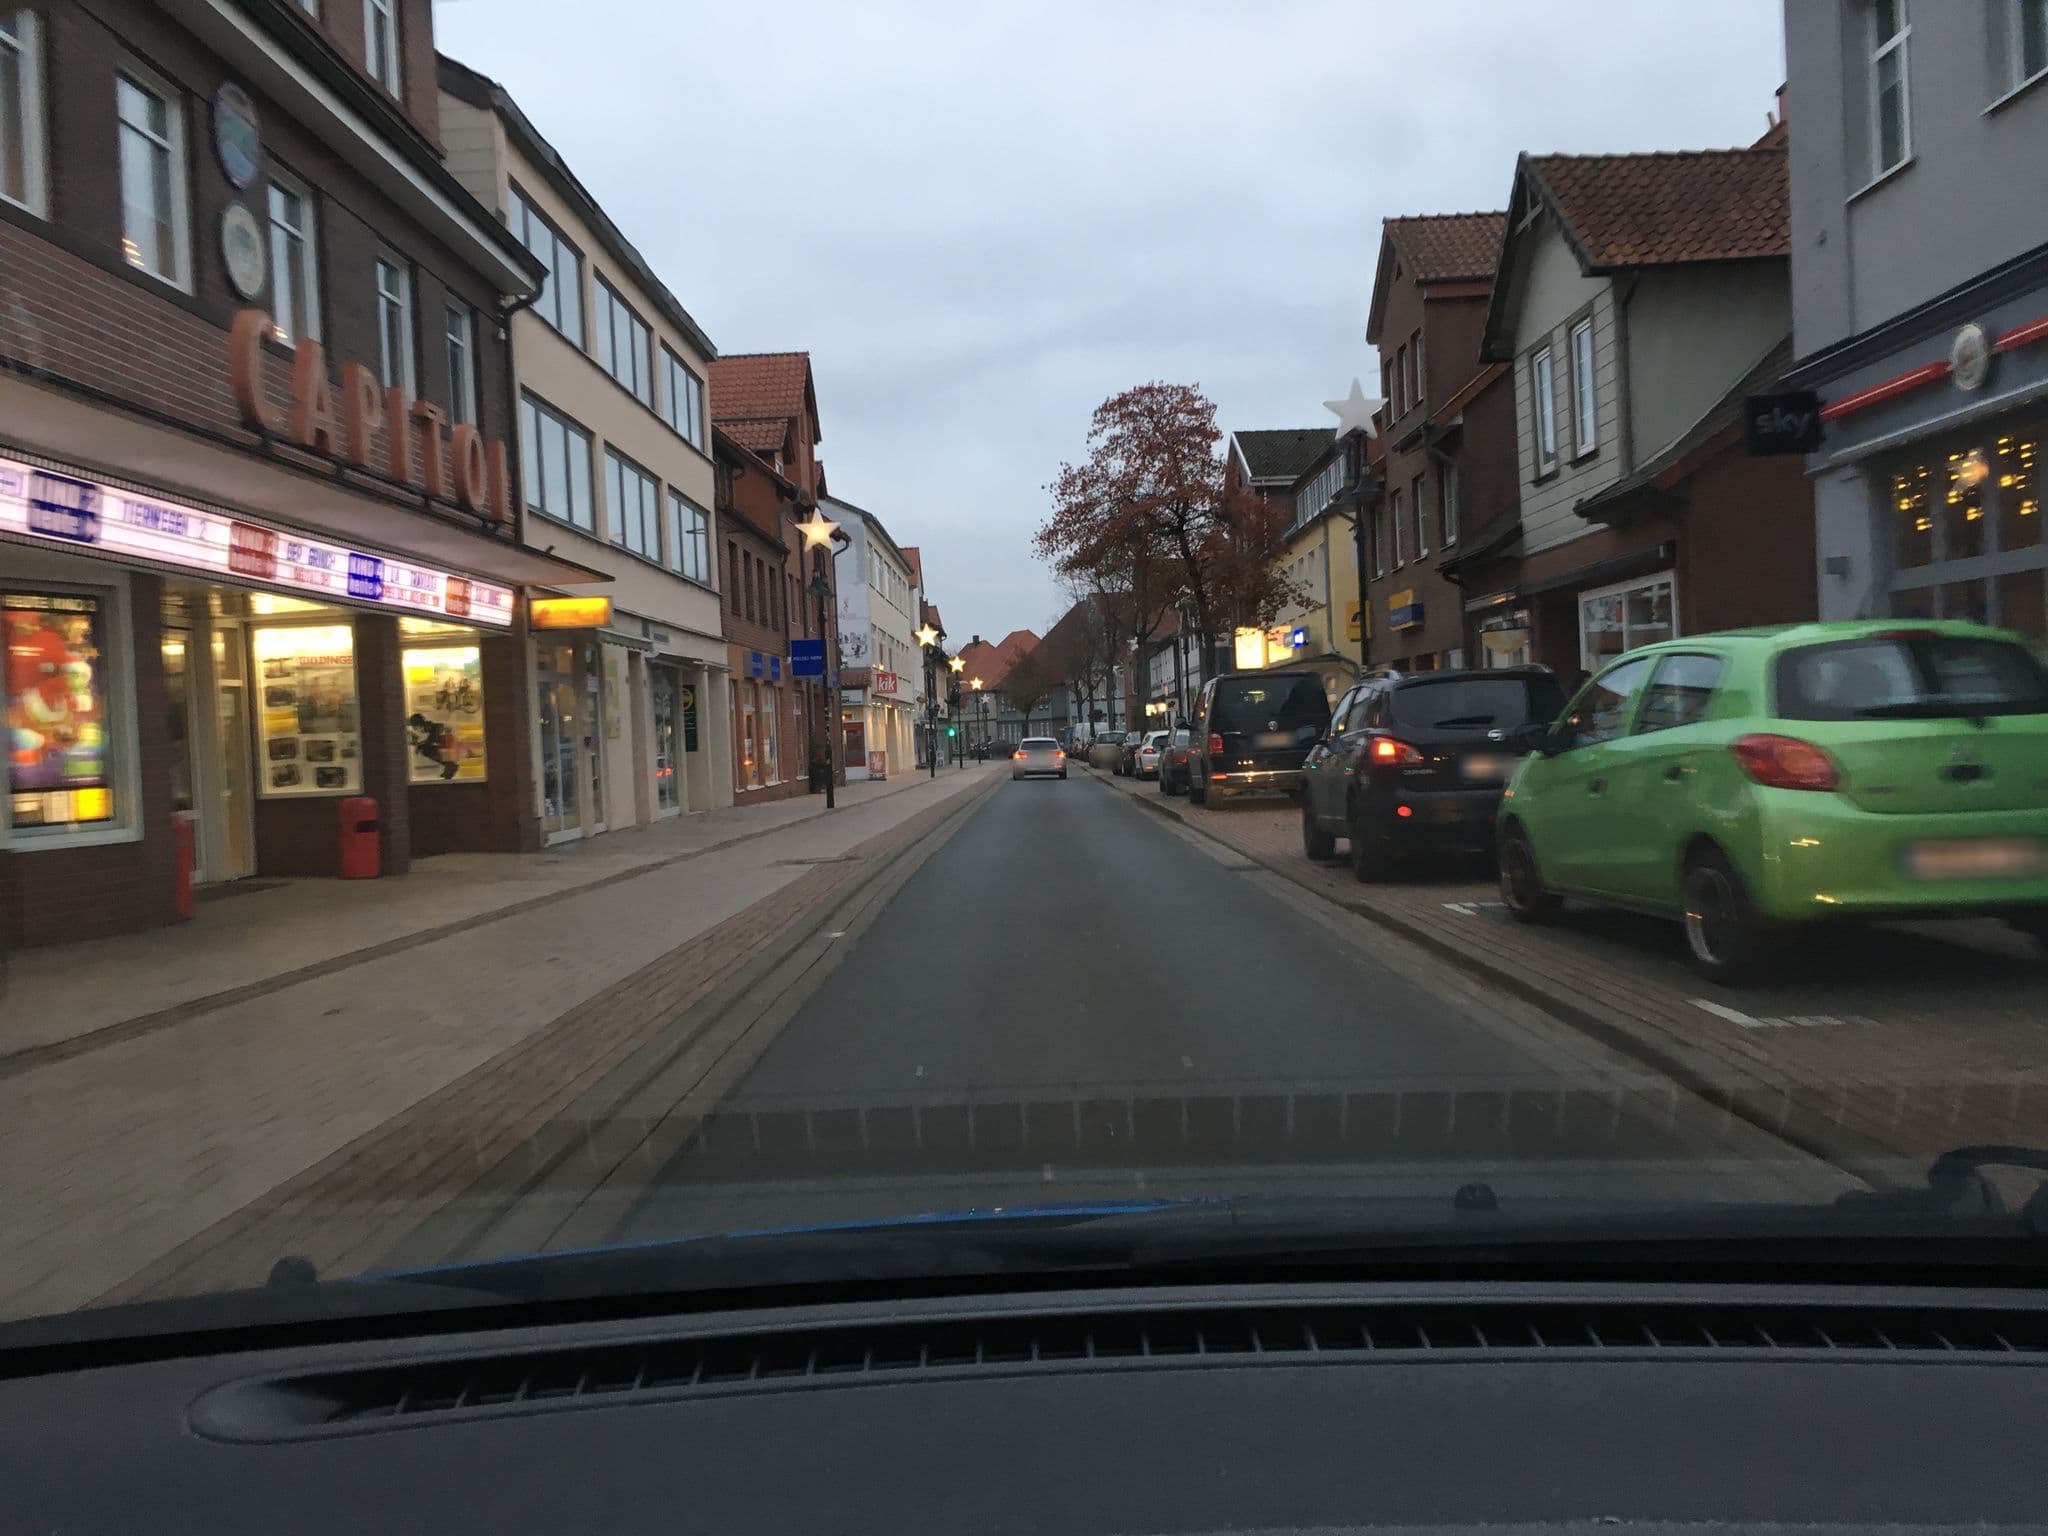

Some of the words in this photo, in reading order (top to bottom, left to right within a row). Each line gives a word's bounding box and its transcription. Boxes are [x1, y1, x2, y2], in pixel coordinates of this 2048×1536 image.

[230, 308, 514, 523] CAPITOL
[1756, 408, 1808, 439] sky
[878, 676, 896, 691] kik
